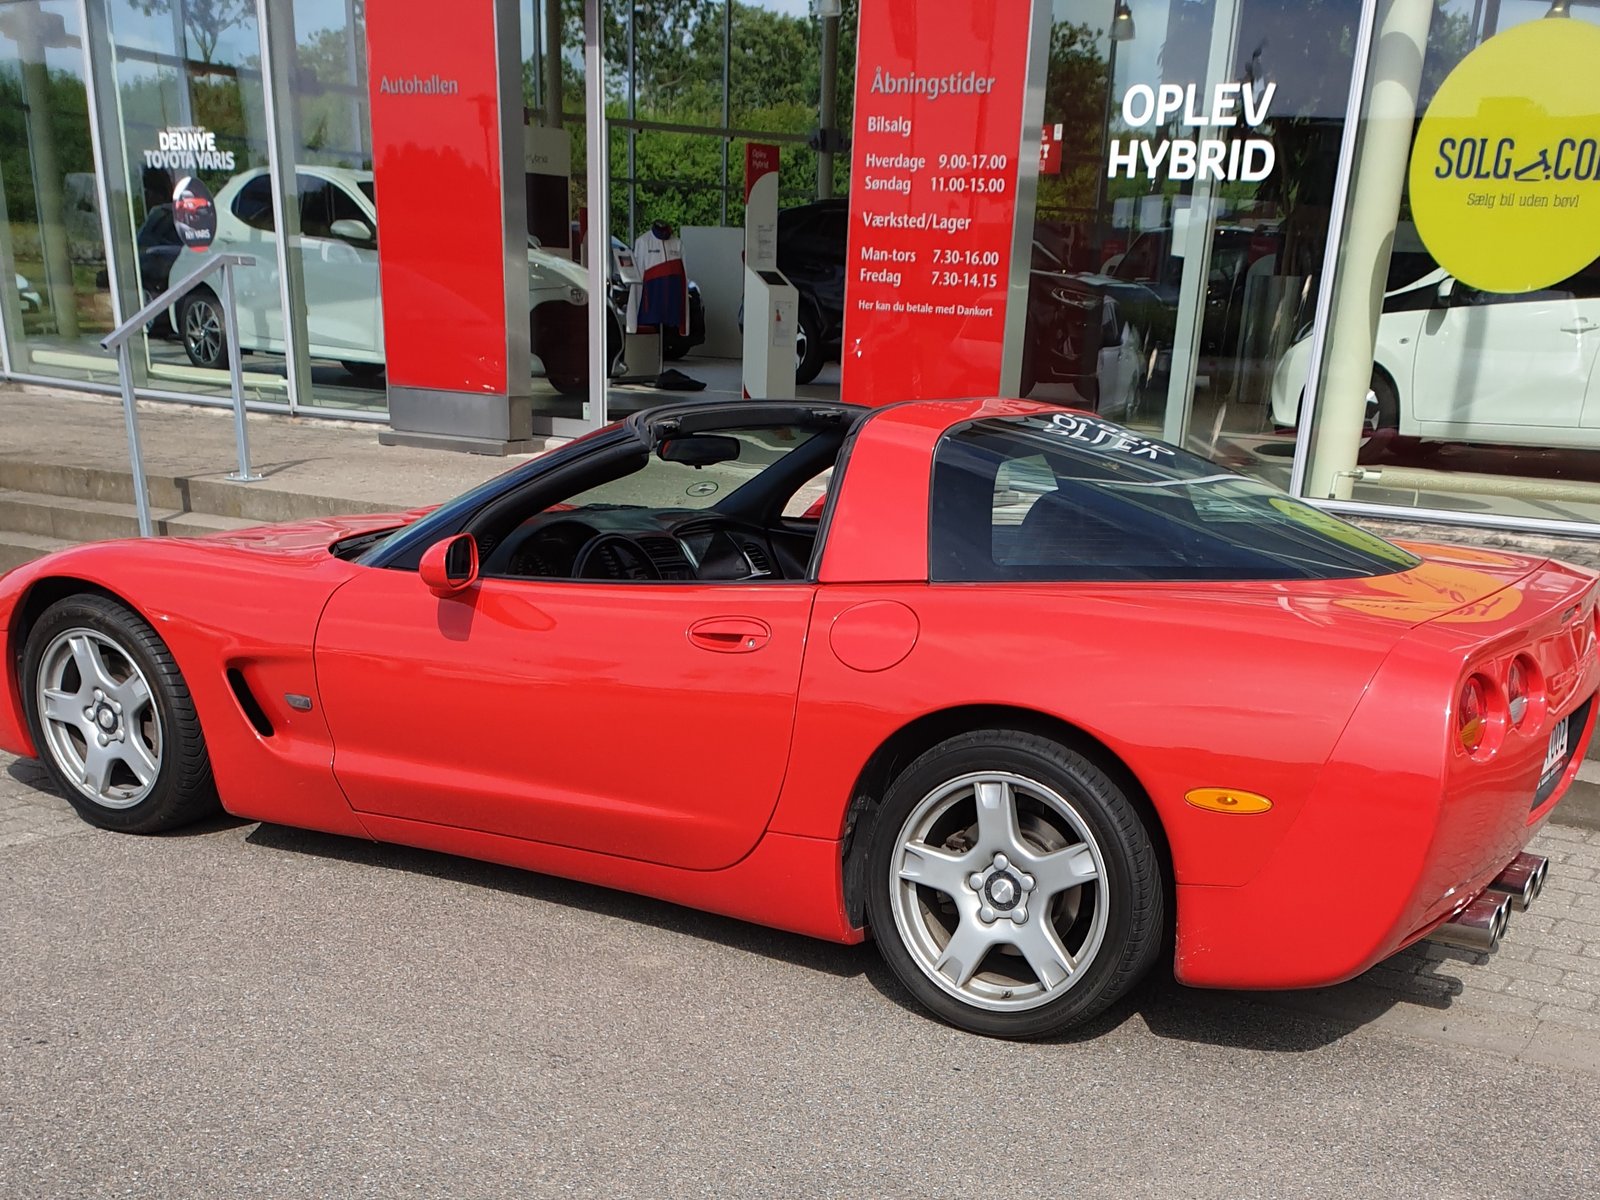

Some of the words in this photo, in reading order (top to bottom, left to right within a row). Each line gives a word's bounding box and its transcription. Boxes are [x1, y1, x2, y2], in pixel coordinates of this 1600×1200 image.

[380, 74, 458, 94] Autohallen
[871, 66, 995, 99] Åbningstider
[1122, 81, 1277, 127] OPLEV
[867, 116, 912, 137] Bilsalg
[159, 132, 188, 151] DEN
[188, 132, 216, 152] NYE
[144, 150, 196, 169] TOYOTA
[196, 151, 235, 170] YARIS
[865, 153, 926, 172] Hverdage
[938, 155, 1007, 170] 9.00-17.00
[1107, 139, 1276, 181] HYBRID
[865, 176, 912, 195] Søndag
[930, 177, 1006, 193] 11.00-15.00
[1466, 192, 1496, 209] Sælg
[1500, 193, 1516, 206] bil
[1519, 195, 1549, 208] uden
[862, 211, 972, 234] Værksted/Lager
[860, 246, 916, 263] Man-tors
[932, 249, 1000, 266] 7.30-16.00
[859, 268, 902, 287] Fredag
[858, 299, 873, 310] Her
[875, 300, 891, 312] kan
[893, 301, 905, 312] du
[906, 302, 933, 314] betale
[935, 304, 955, 315] med
[957, 304, 993, 317] Dankort
